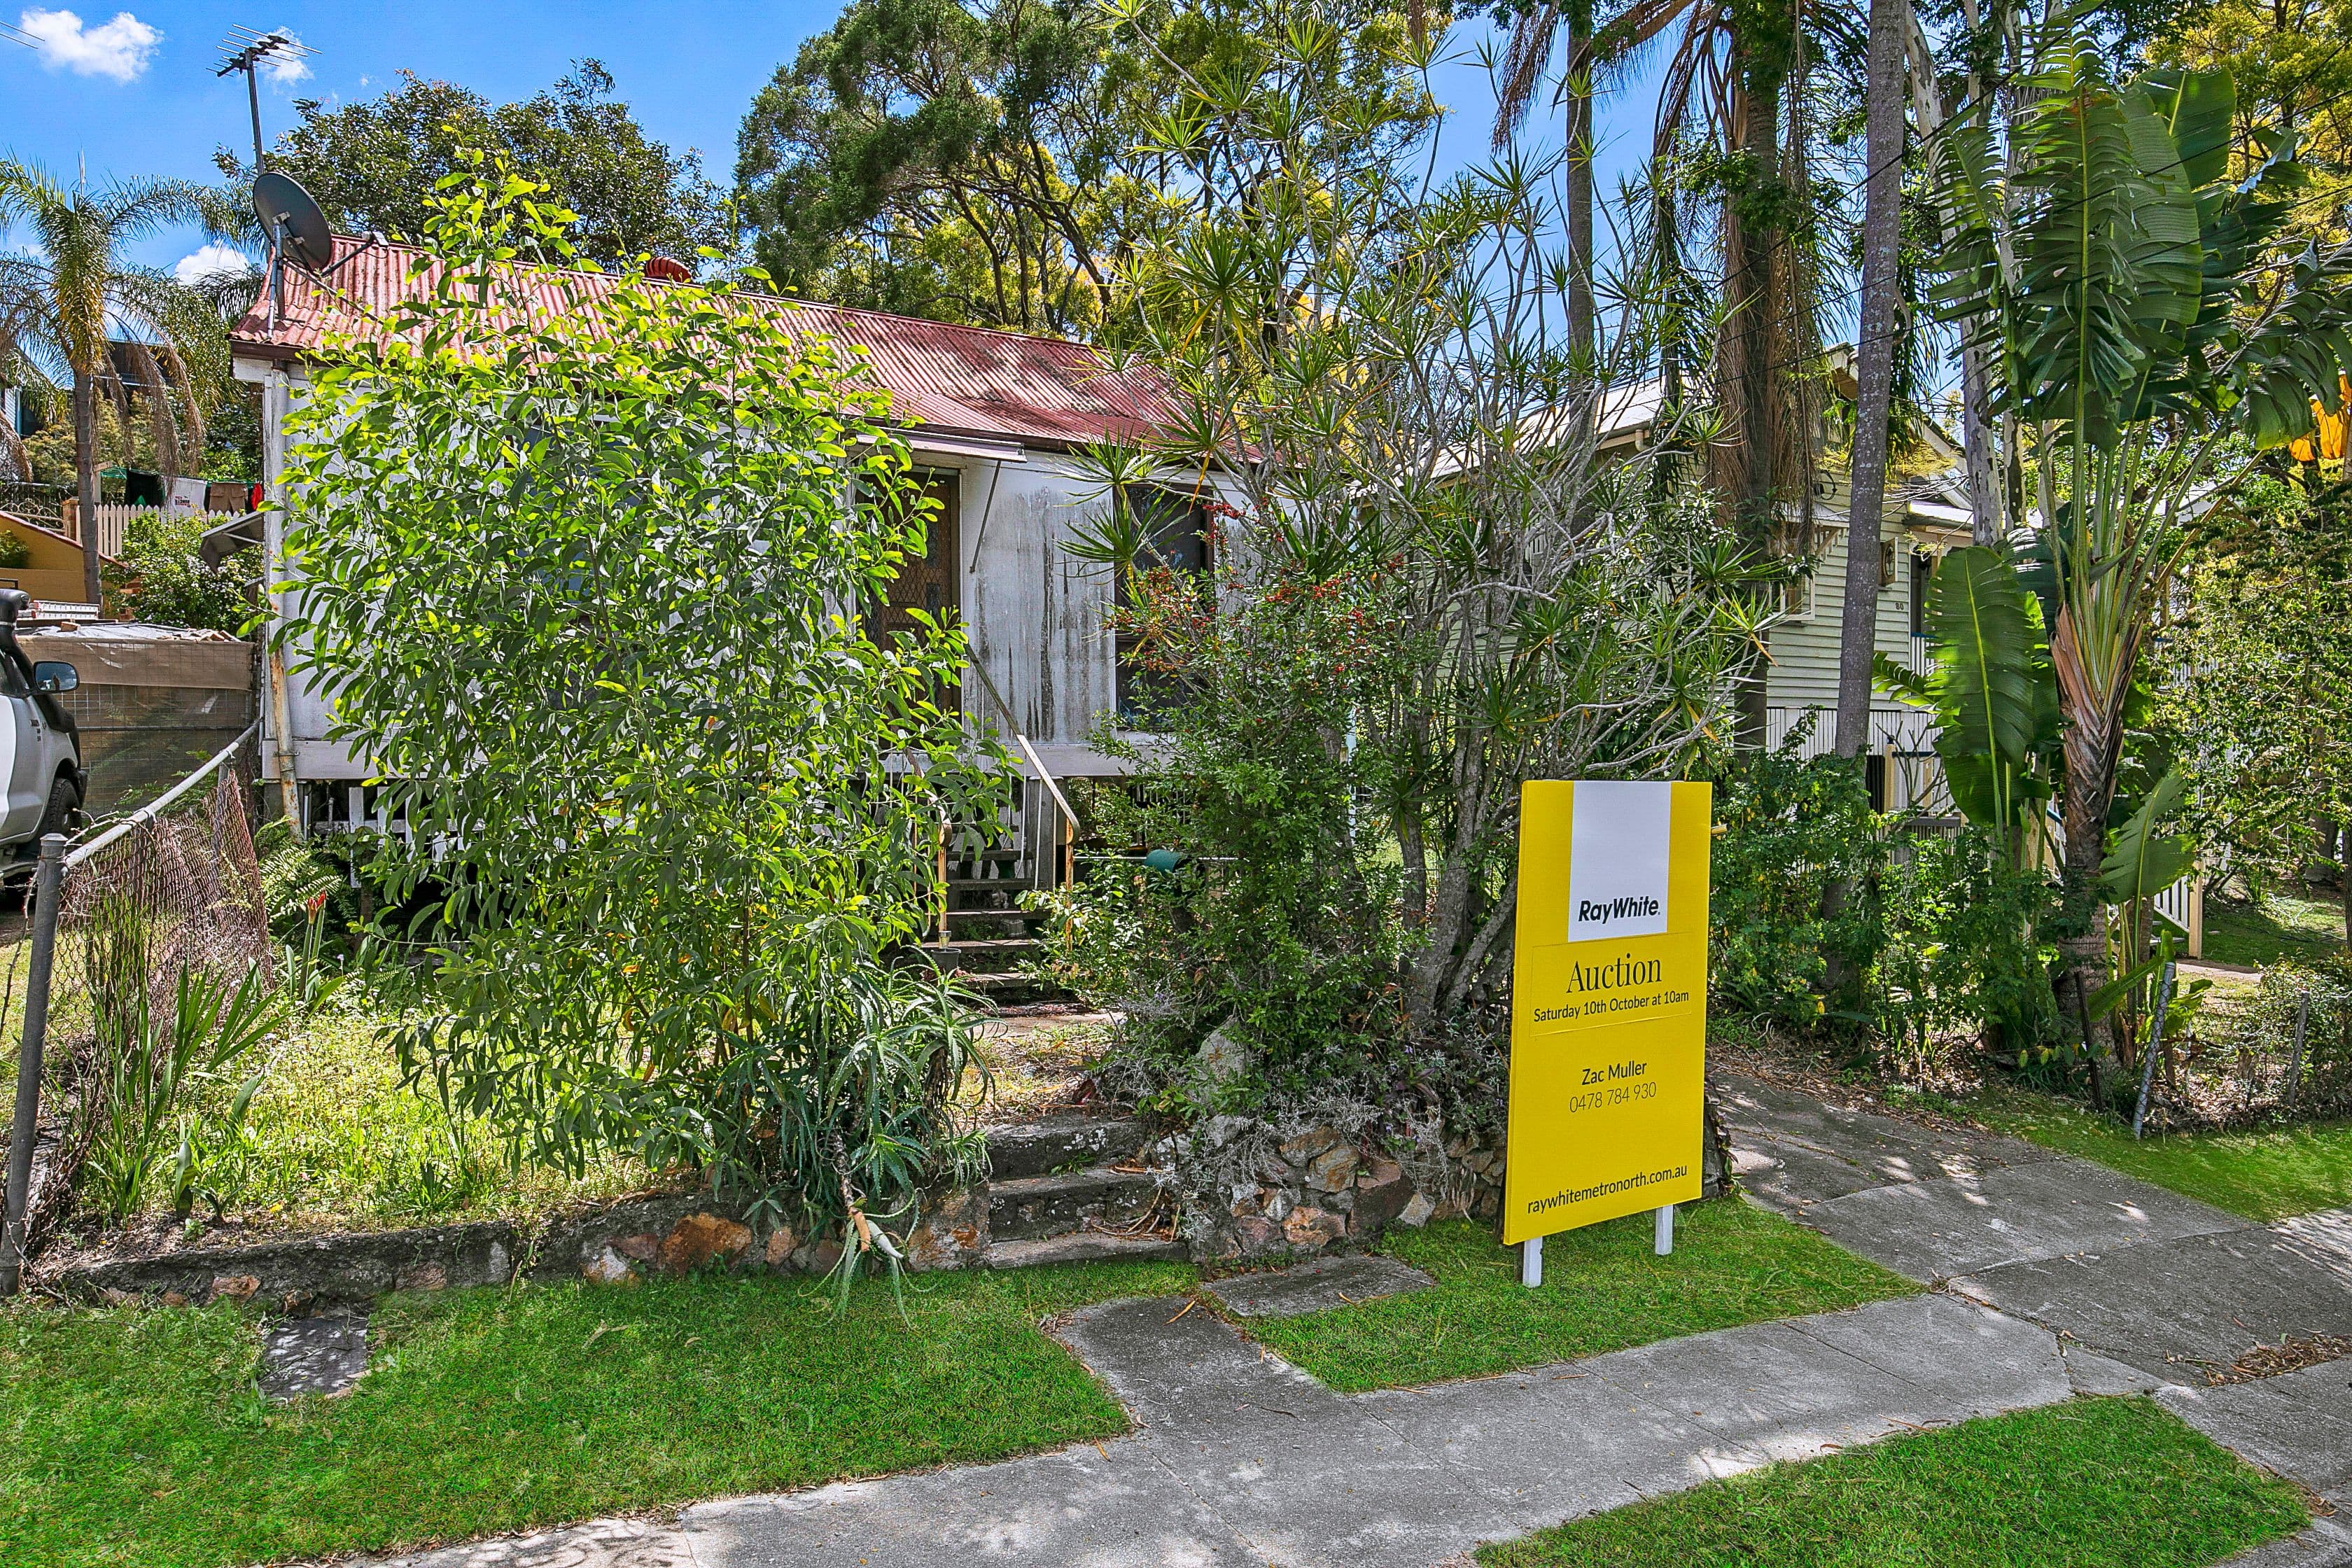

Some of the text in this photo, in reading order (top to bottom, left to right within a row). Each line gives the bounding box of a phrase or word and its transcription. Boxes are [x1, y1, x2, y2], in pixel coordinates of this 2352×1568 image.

[1895, 602, 1904, 610] 80
[1566, 953, 1662, 993] Auction
[1534, 990, 1689, 1023] Saturday 10th October at 10am
[1581, 1060, 1647, 1086] Zac Muller
[1569, 1082, 1657, 1113] 0478 784 930
[1527, 1165, 1688, 1214] raywhitemetronorth.com.au
